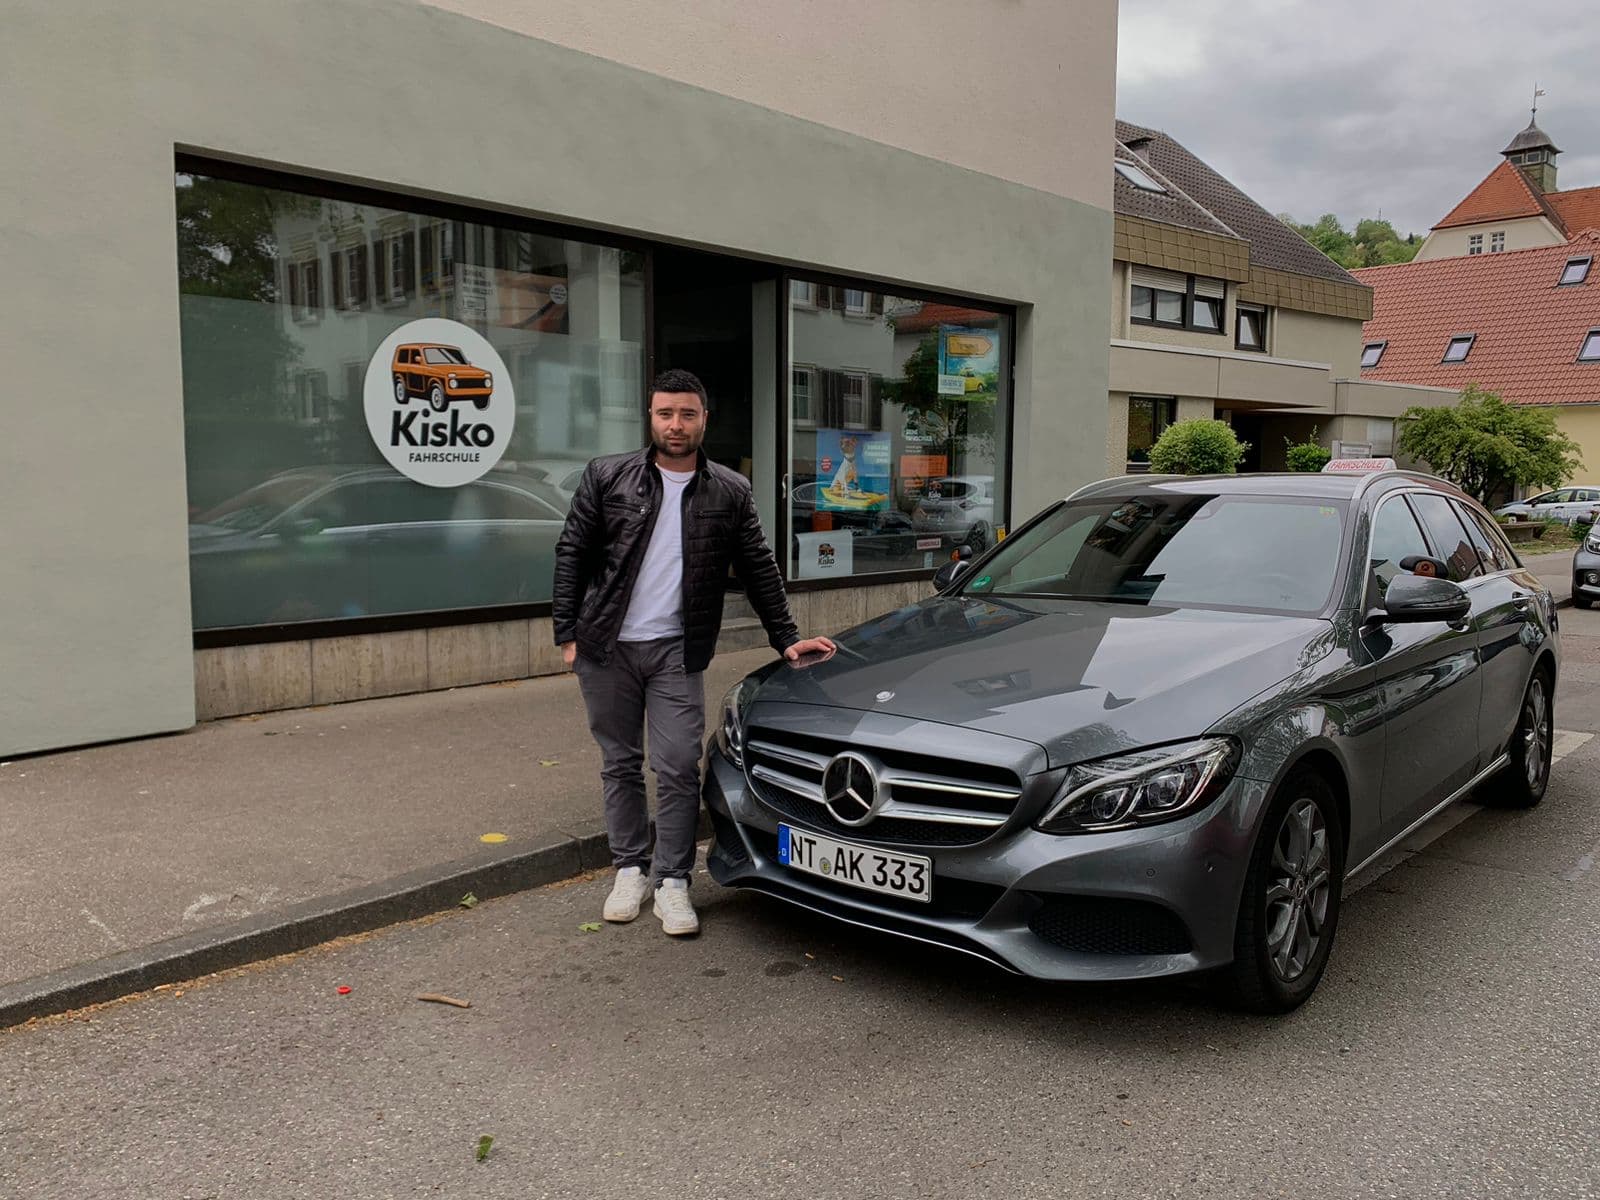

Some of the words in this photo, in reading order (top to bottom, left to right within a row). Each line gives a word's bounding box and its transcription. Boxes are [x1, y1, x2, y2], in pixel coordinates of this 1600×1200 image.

[390, 409, 494, 447] Kisko
[409, 452, 481, 464] FAHRSCHULE
[1331, 461, 1382, 470] FAHRSCHULE
[791, 833, 817, 868] NT
[833, 847, 866, 883] AK
[872, 855, 925, 893] 333
